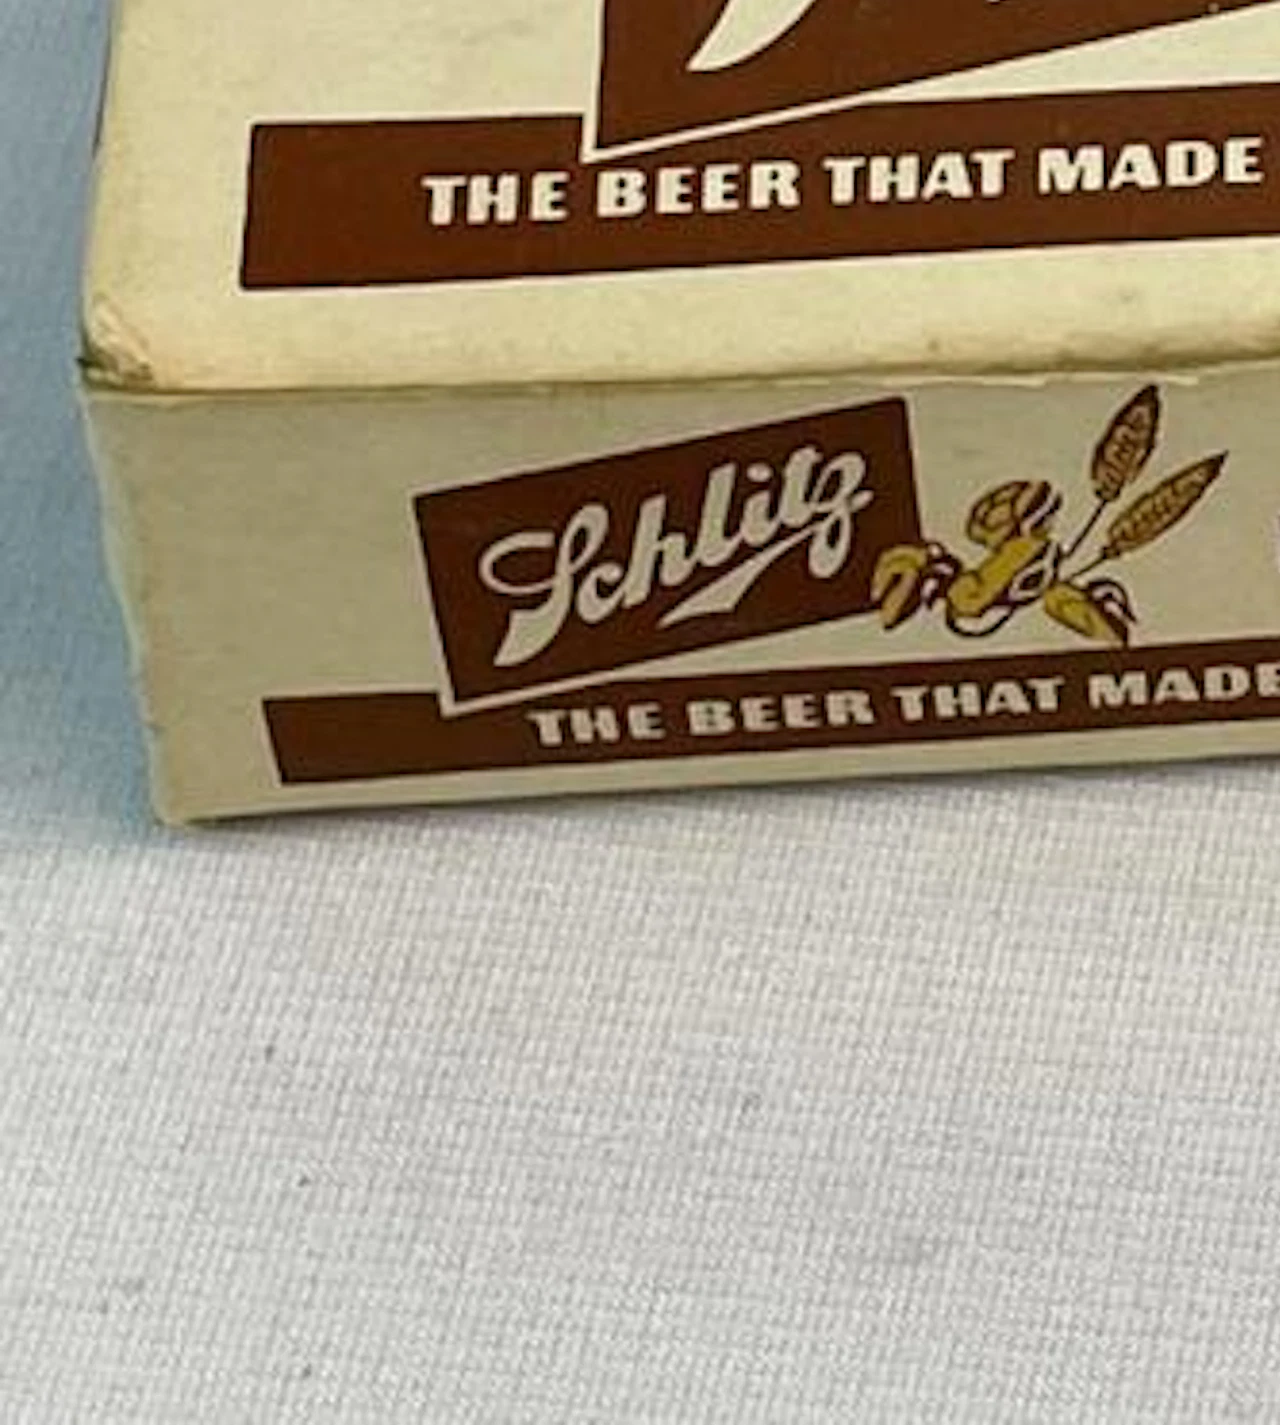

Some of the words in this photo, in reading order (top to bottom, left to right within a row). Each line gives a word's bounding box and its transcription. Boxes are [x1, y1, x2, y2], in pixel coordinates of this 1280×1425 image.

[422, 170, 570, 226] THE
[595, 160, 801, 219] BEER
[823, 148, 1015, 206] THAT
[1037, 135, 1265, 195] MADE
[478, 443, 875, 667] Schlitz
[527, 702, 664, 747] THE
[687, 689, 876, 737] BEER
[891, 677, 1067, 724] THAT
